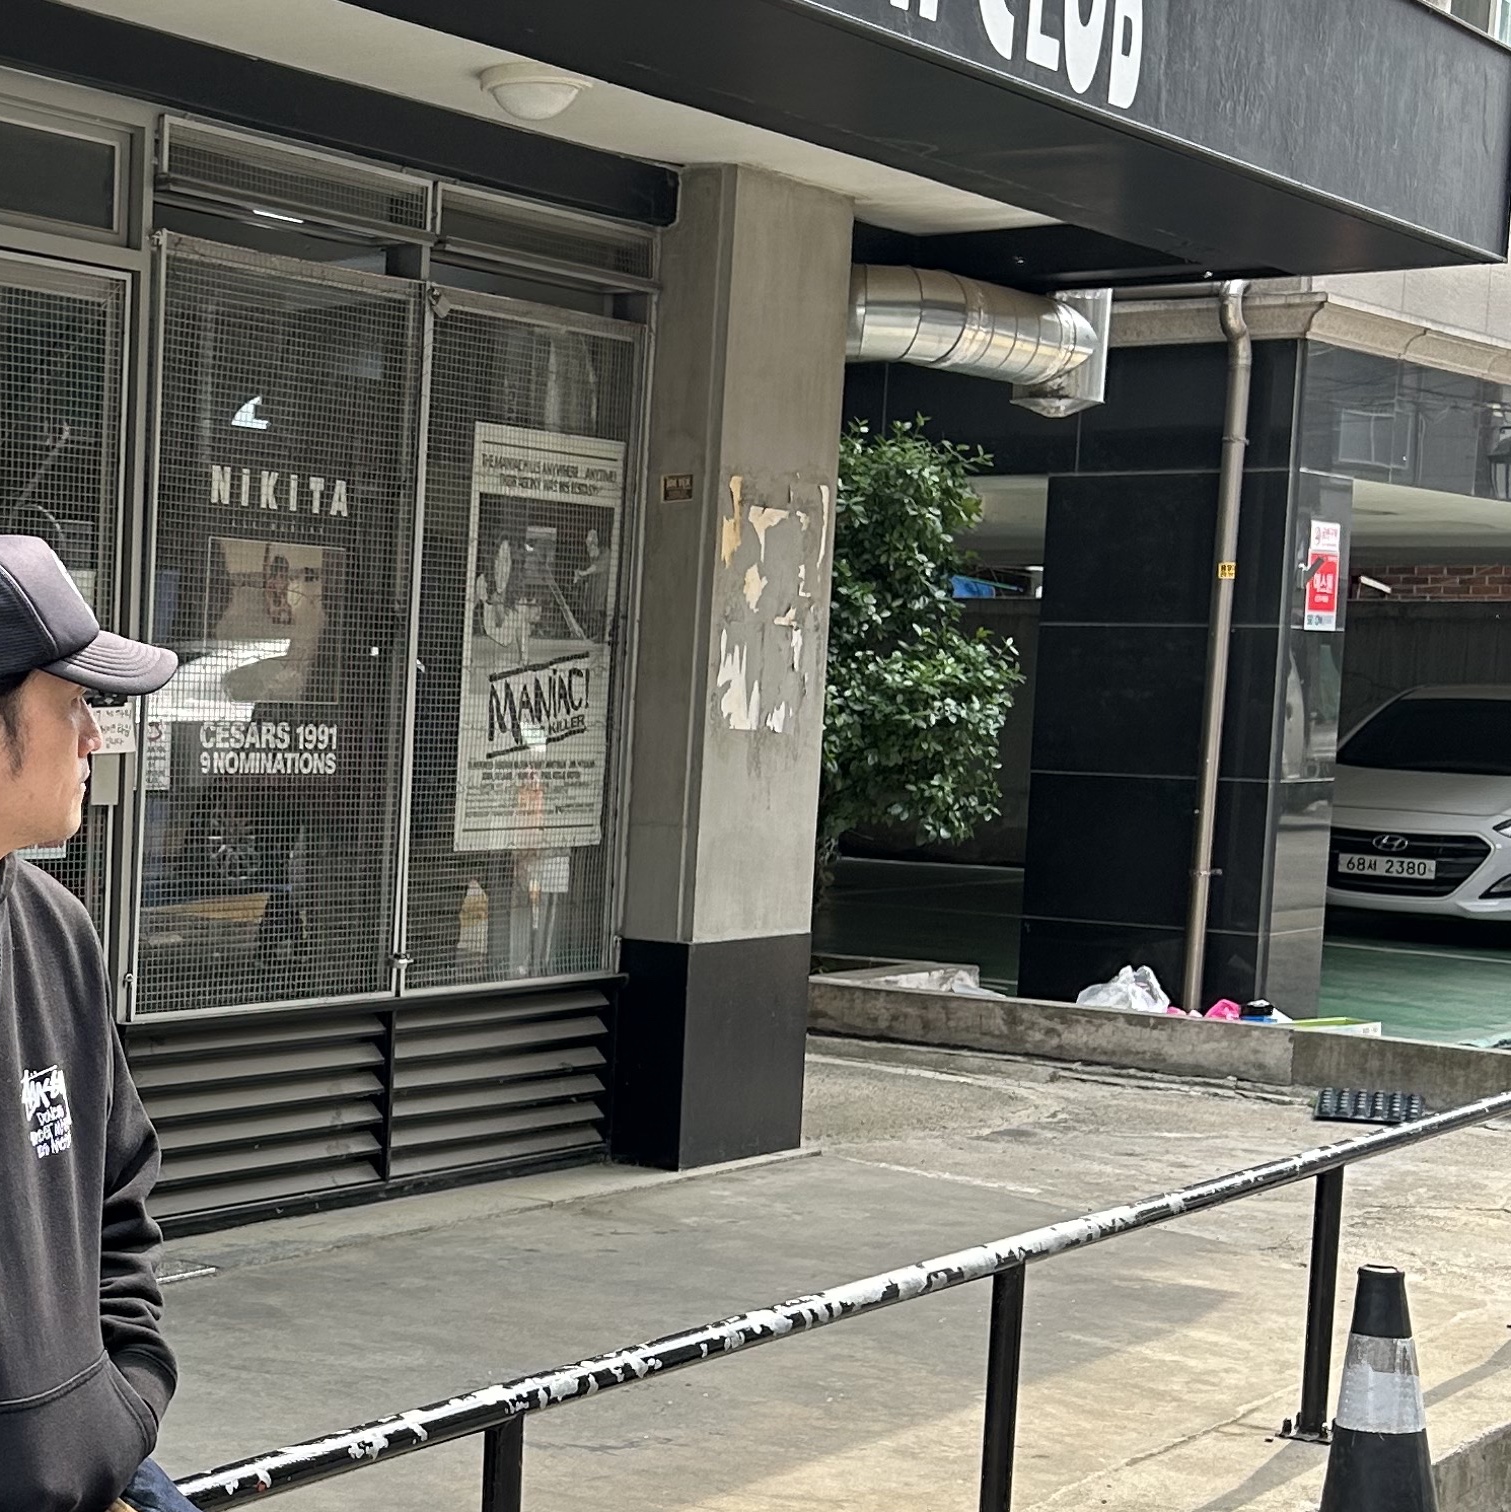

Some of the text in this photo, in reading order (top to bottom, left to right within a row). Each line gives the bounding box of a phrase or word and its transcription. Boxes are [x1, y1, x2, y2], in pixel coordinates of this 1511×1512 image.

[210, 464, 348, 517] NIKITA
[199, 721, 338, 750] CESARS 1991
[199, 751, 337, 774] 9 NOMINATIONS
[1384, 859, 1427, 876] 2380
